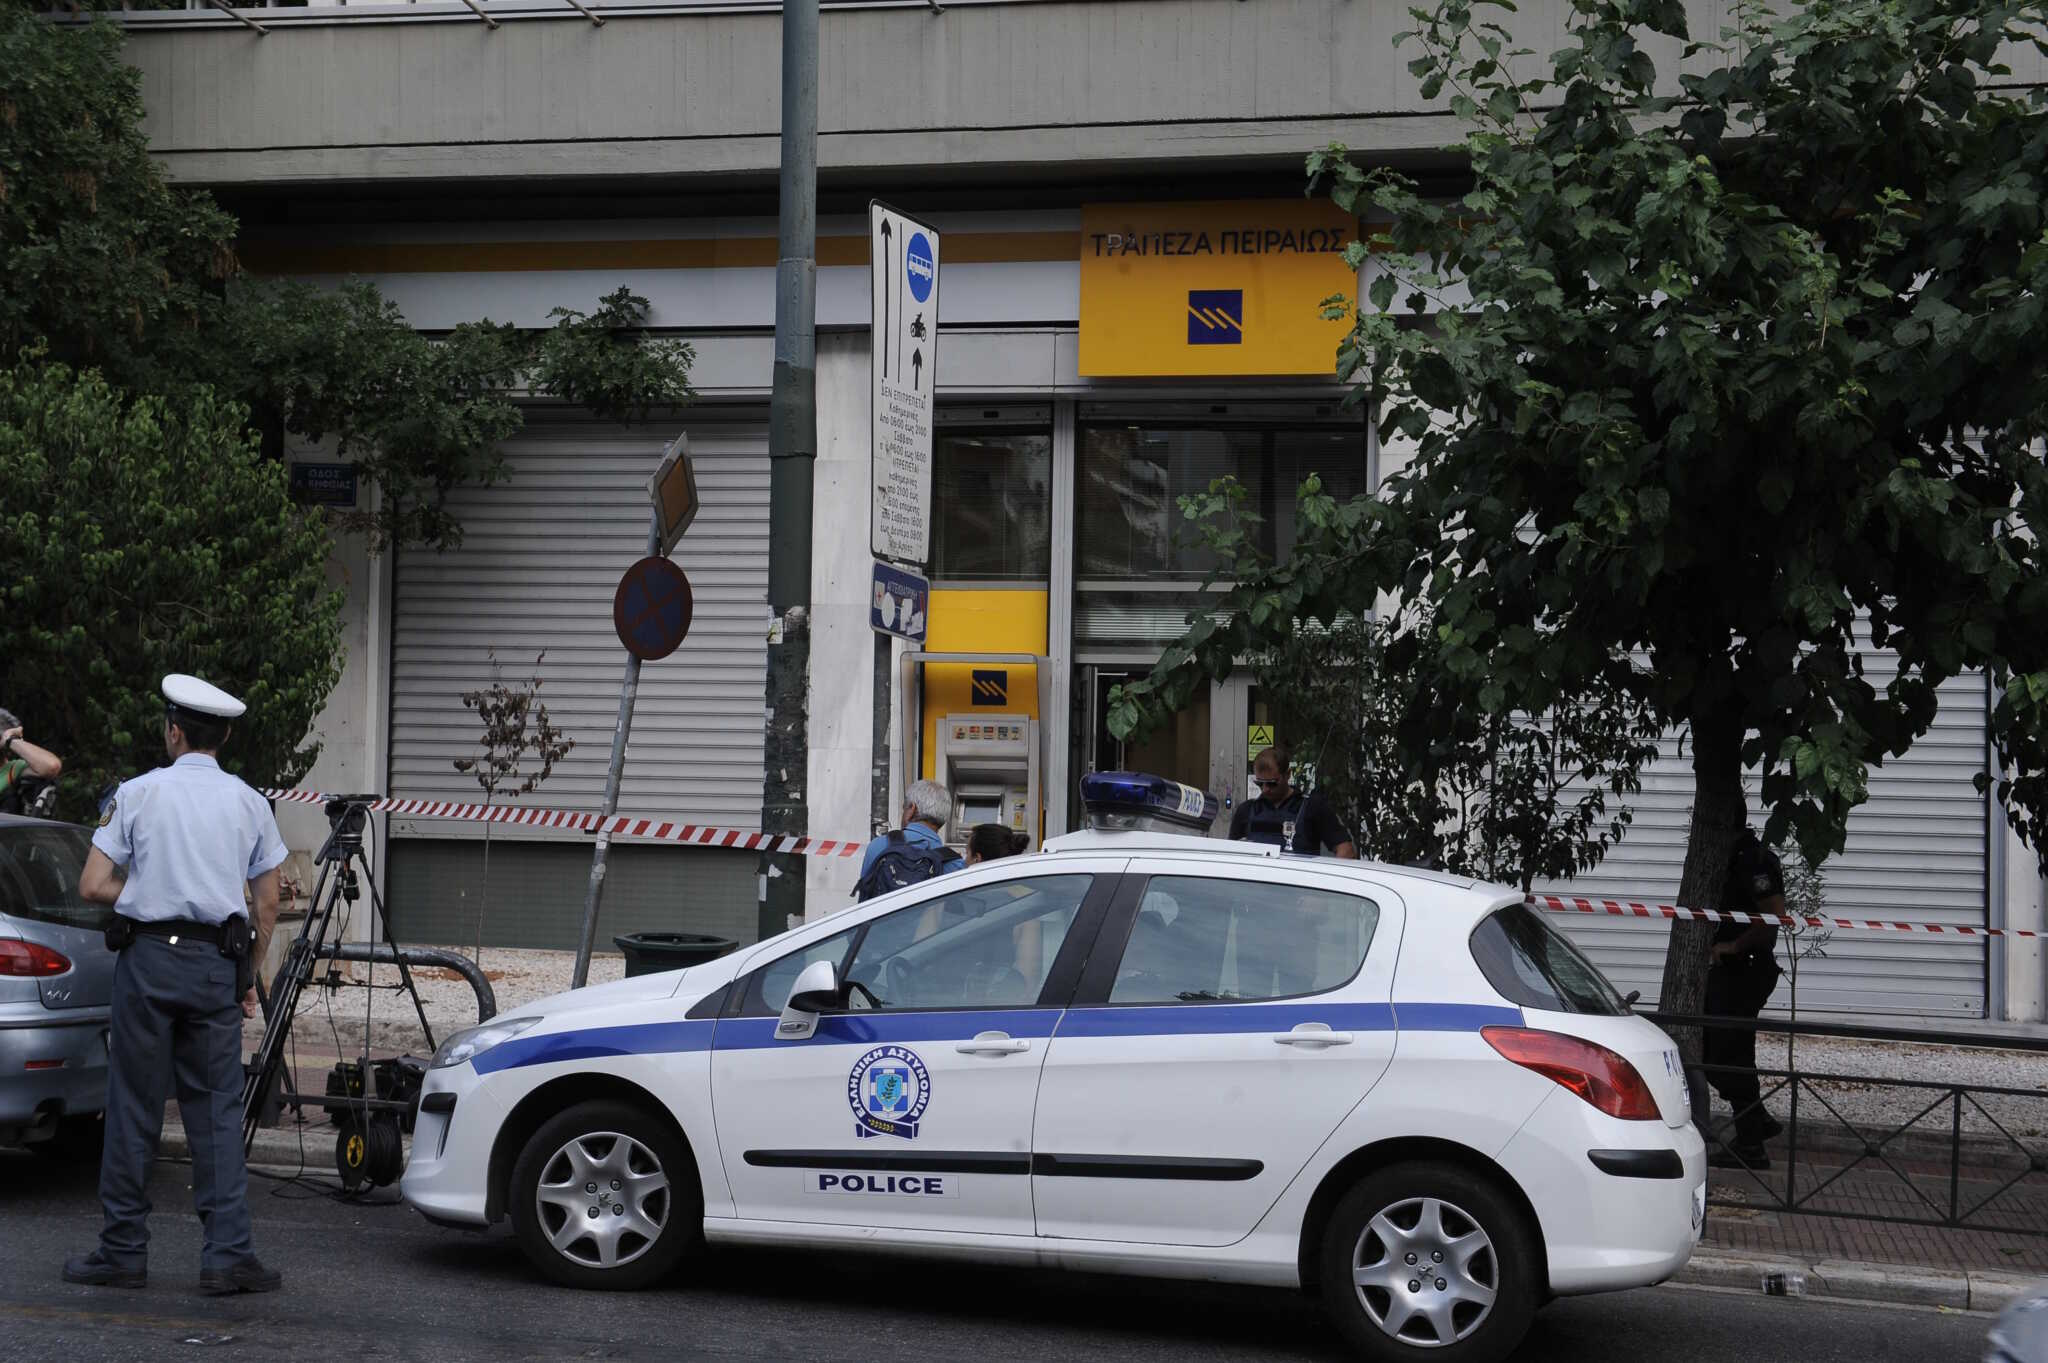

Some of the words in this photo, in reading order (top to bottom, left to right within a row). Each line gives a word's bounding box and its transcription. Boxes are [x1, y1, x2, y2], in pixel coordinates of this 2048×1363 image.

[1091, 232, 1212, 257] ΤΡΑΠΕΖΑ
[1221, 228, 1346, 255] ΠΕΙΡΑΙΩΣ
[849, 1048, 884, 1118] ΕΛΛΗΝΙΚΗ
[887, 1047, 930, 1118] ΑΣΤΥΝΟΜΙΑ
[818, 1174, 943, 1195] POLICE
